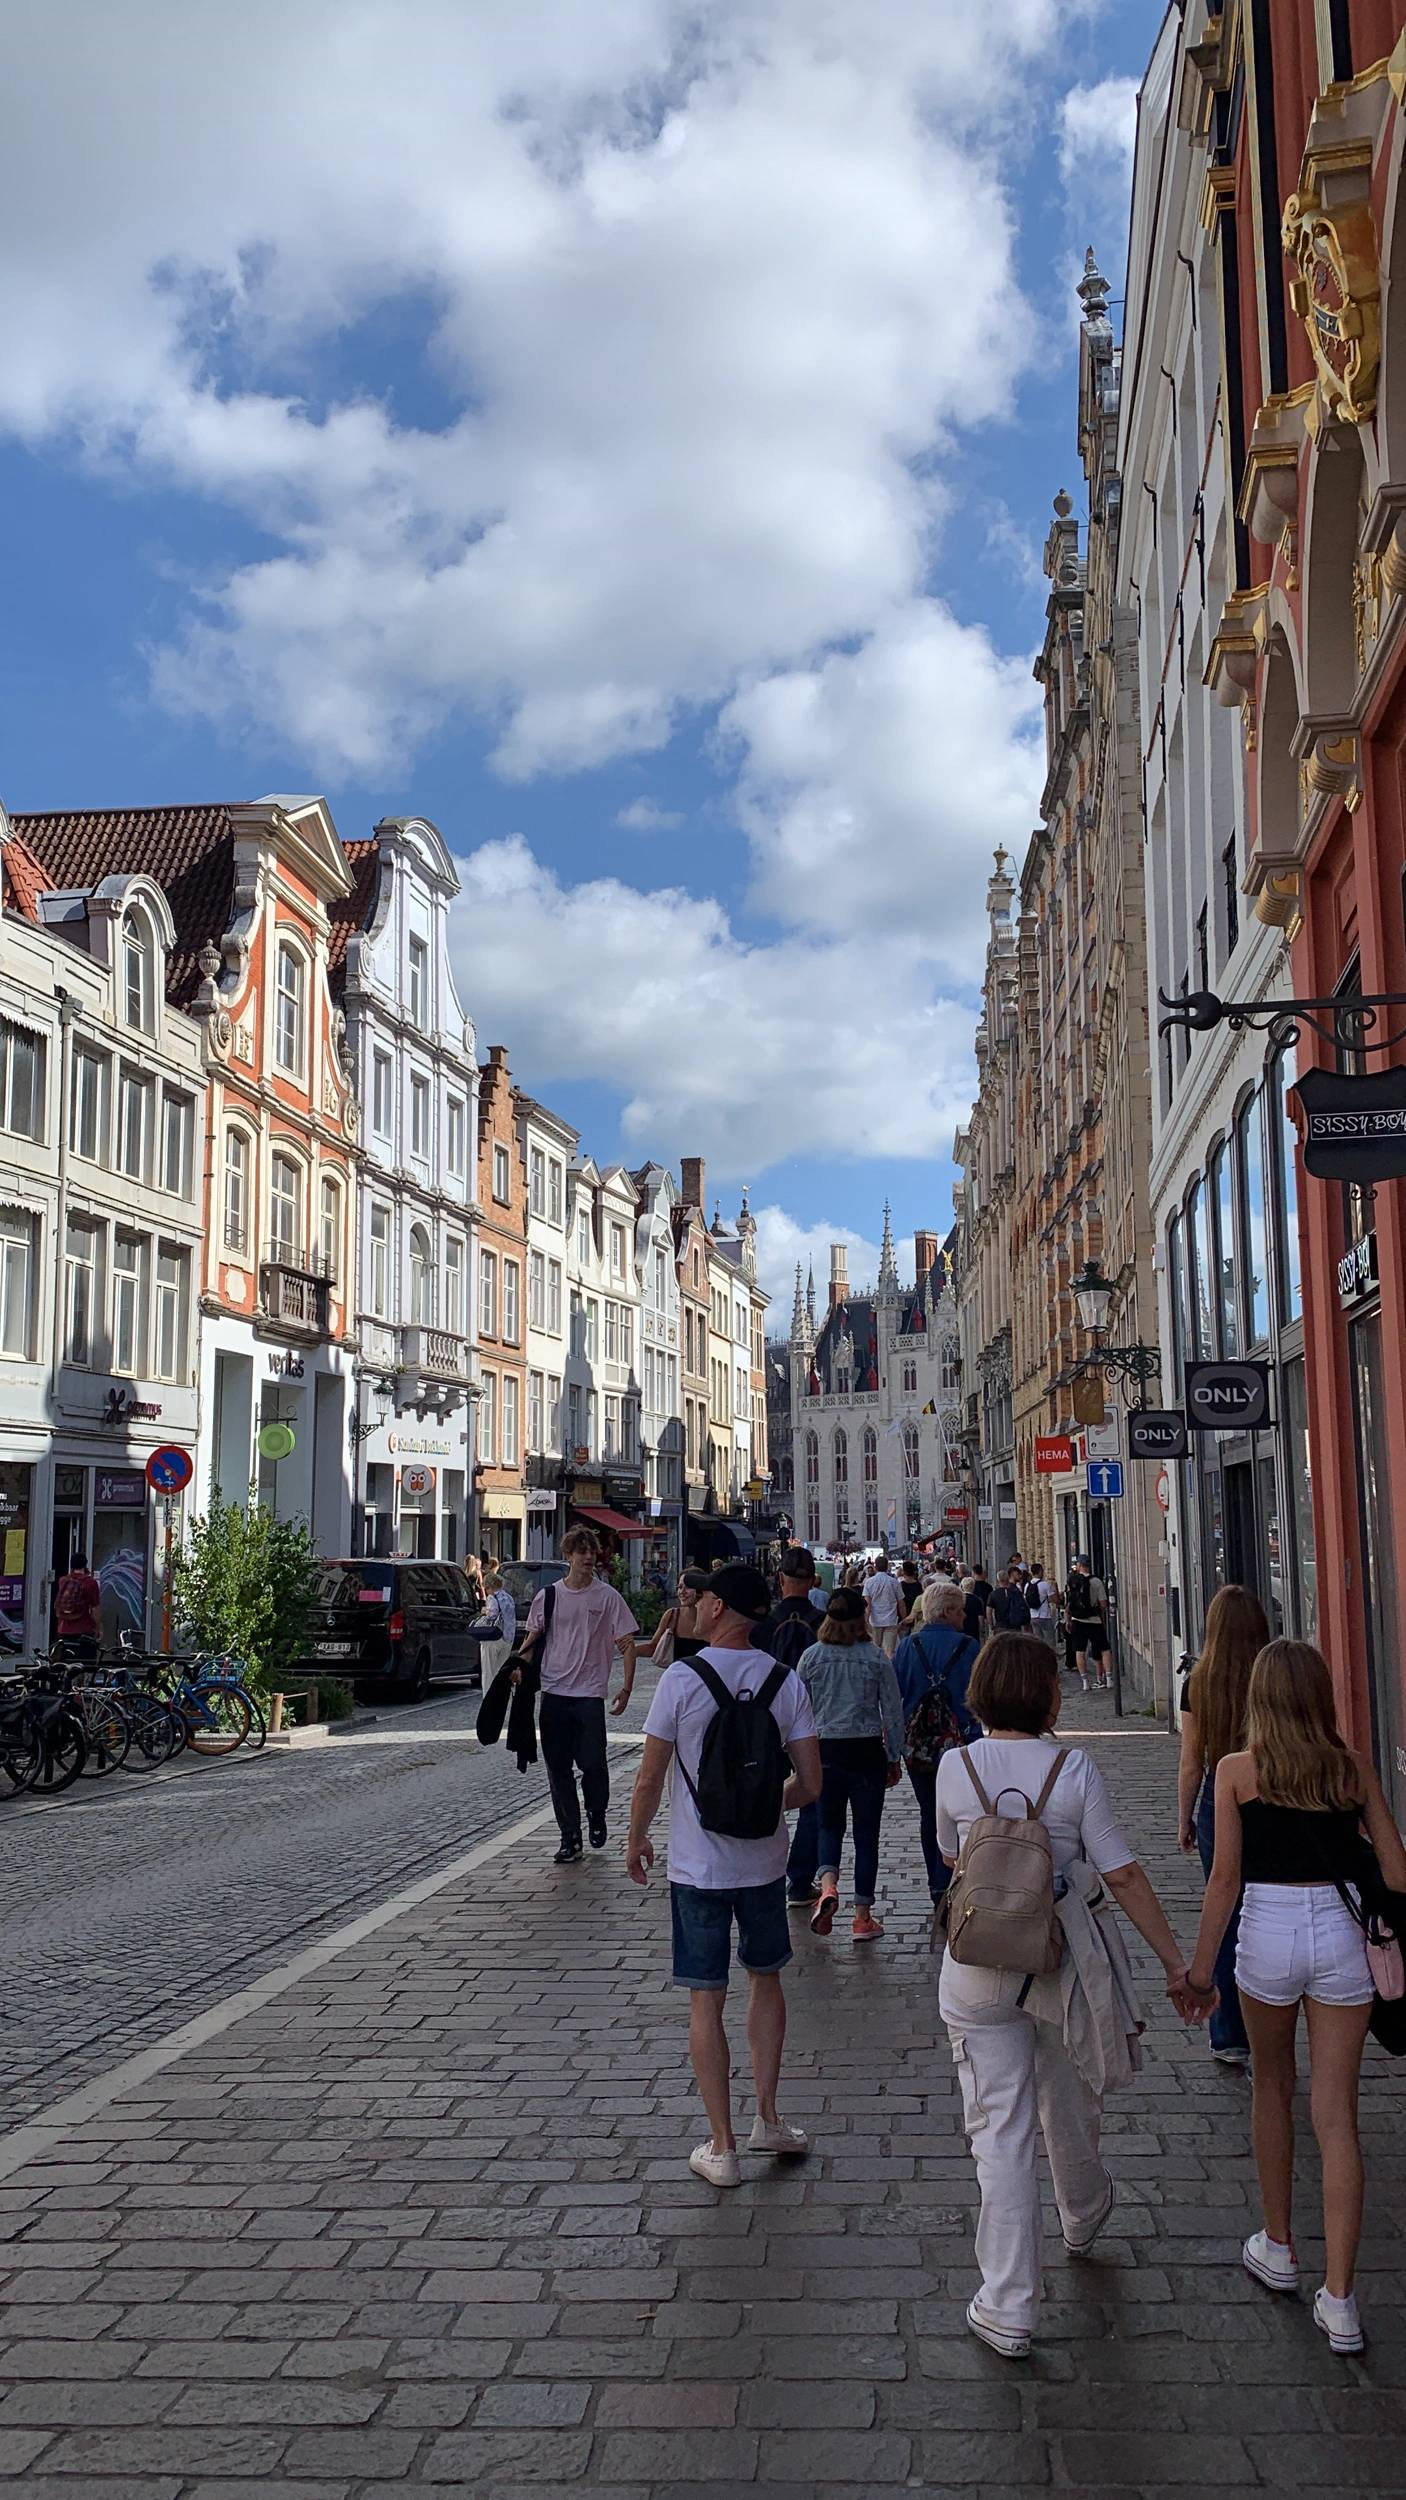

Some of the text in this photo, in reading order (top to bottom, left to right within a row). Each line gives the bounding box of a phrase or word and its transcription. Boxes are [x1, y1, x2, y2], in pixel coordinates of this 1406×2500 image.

[268, 1352, 304, 1379] veritas
[1194, 1387, 1259, 1403] ONLY
[1134, 1428, 1180, 1440] ONLY
[1037, 1450, 1070, 1460] HEMA
